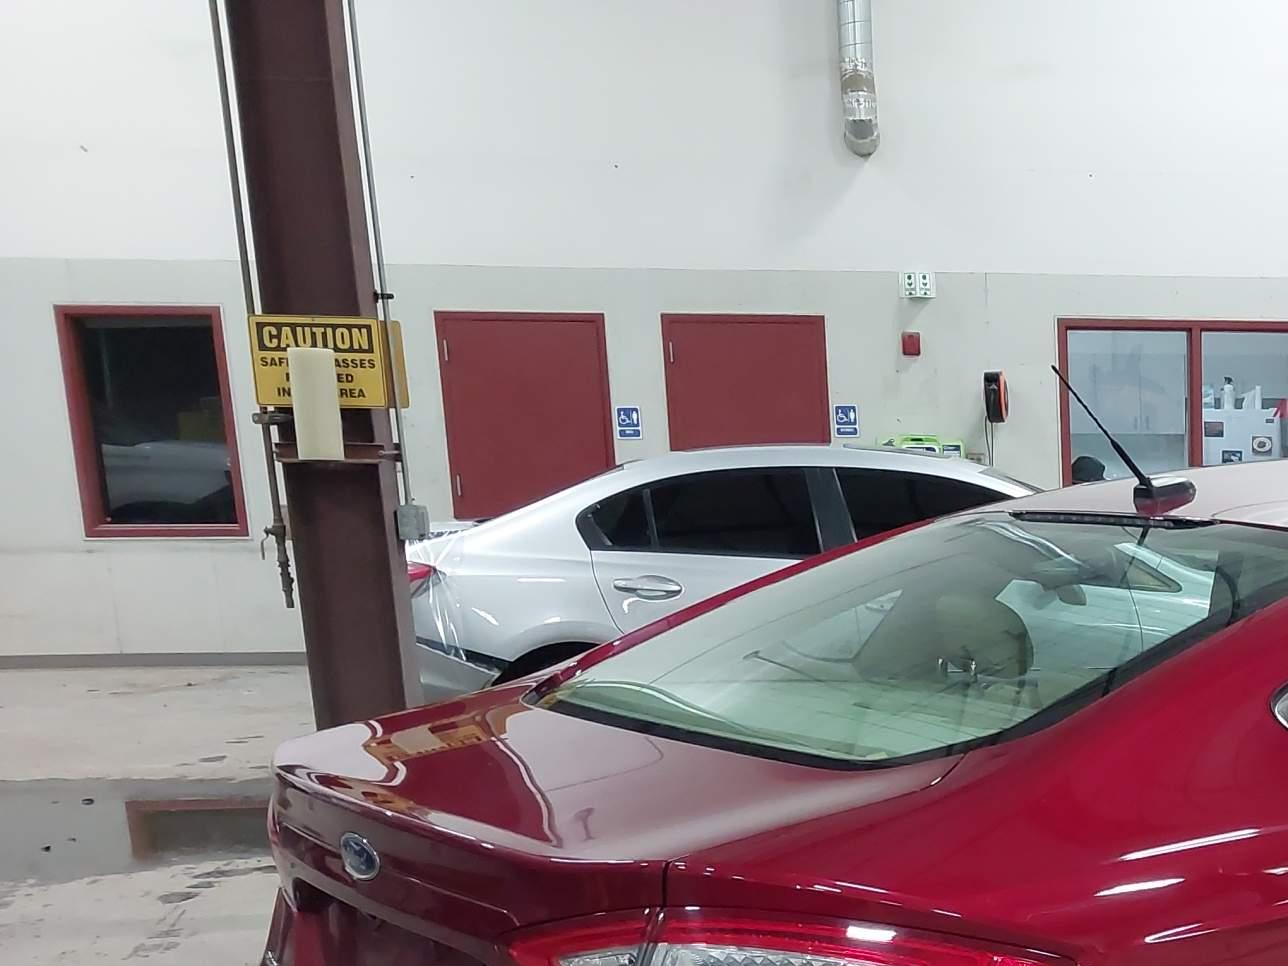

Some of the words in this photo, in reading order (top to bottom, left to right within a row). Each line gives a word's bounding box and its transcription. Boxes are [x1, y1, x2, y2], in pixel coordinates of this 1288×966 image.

[262, 325, 370, 350] CAUTION
[335, 358, 376, 369] ASSES
[340, 388, 366, 399] REA
